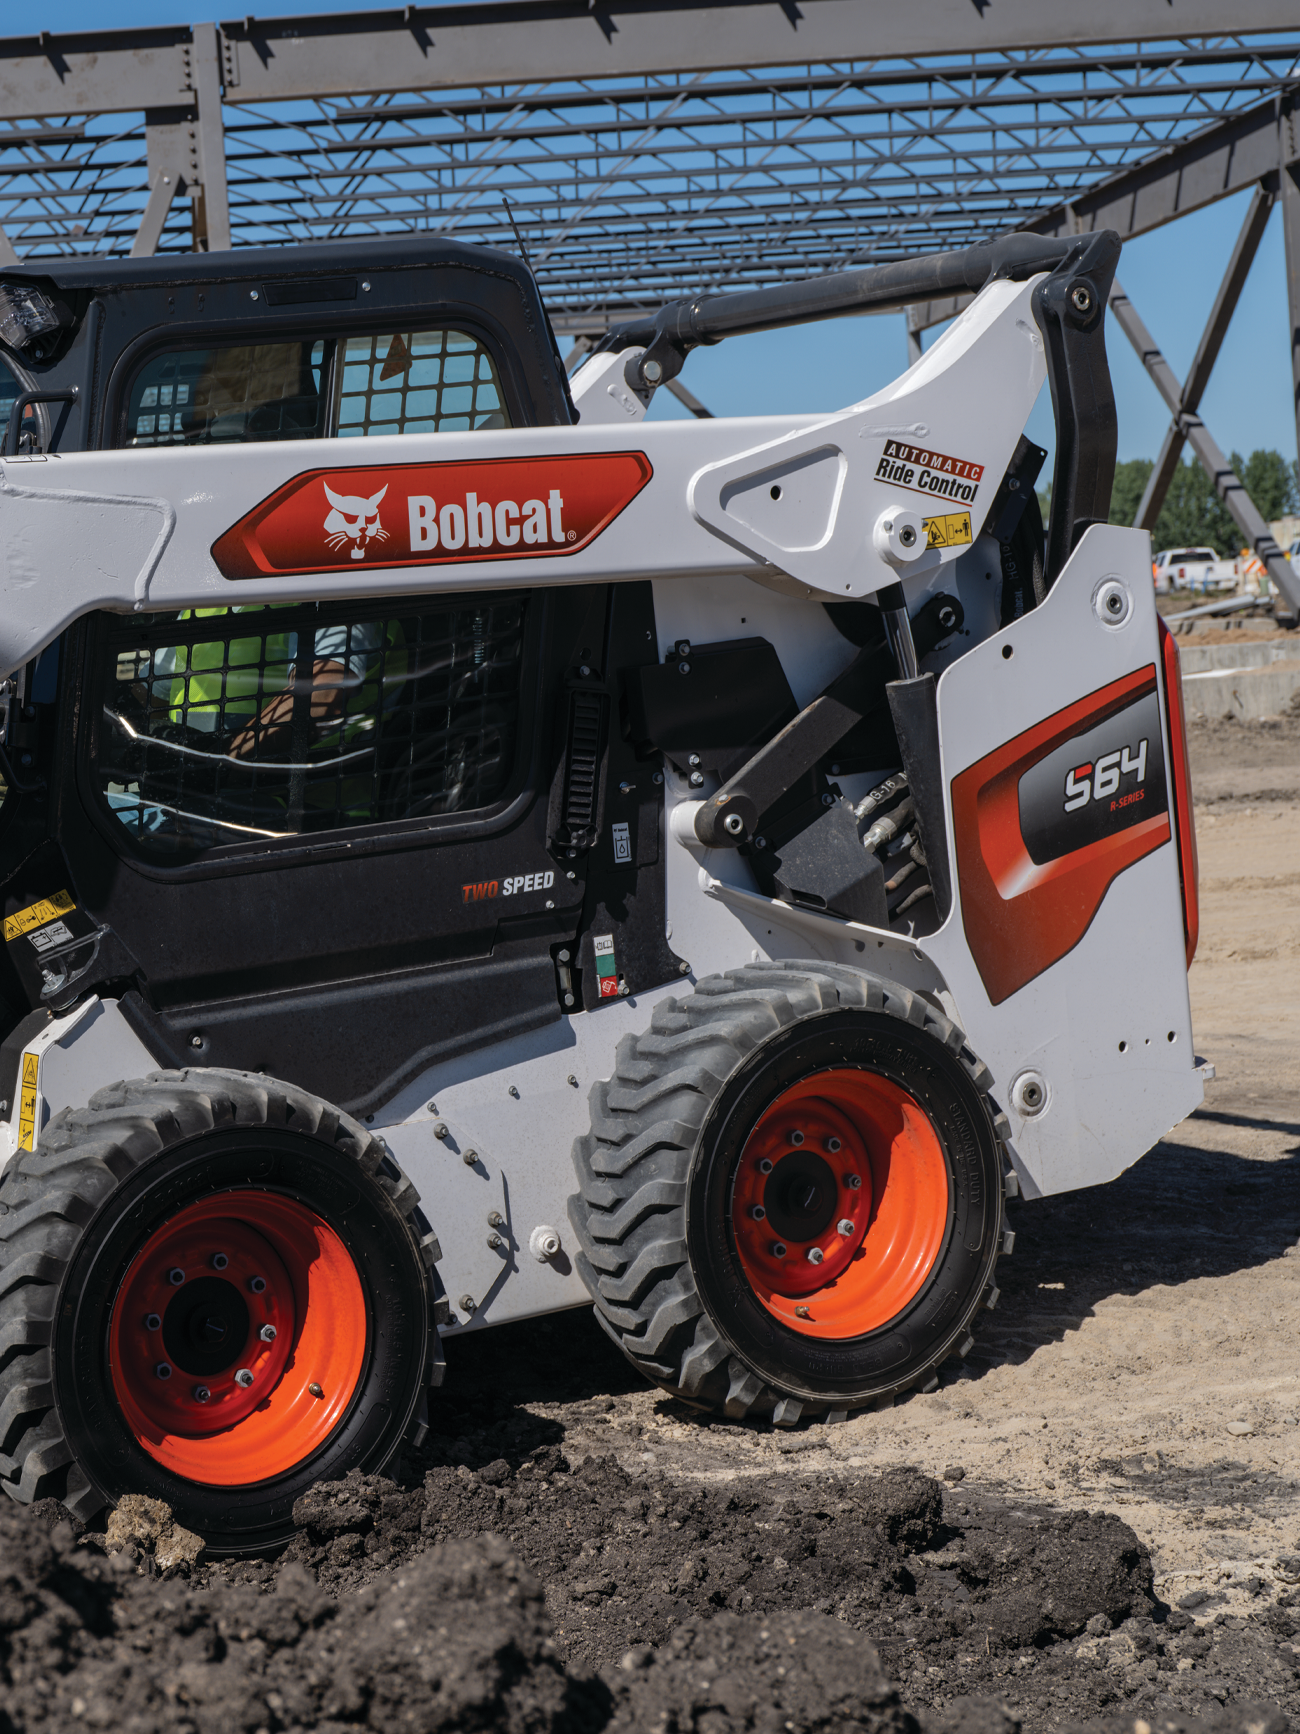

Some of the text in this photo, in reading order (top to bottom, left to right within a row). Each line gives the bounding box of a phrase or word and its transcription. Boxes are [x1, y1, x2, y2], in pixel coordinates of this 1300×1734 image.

[875, 457, 979, 502] Ride Control
[887, 443, 980, 479] AUTOMATIC
[407, 489, 566, 552] Bobcat
[1064, 739, 1148, 813] S64
[1110, 789, 1145, 812] R-SERIES
[462, 871, 555, 902] TWO SPEED
[949, 1102, 981, 1205] STANDARD DUTY
